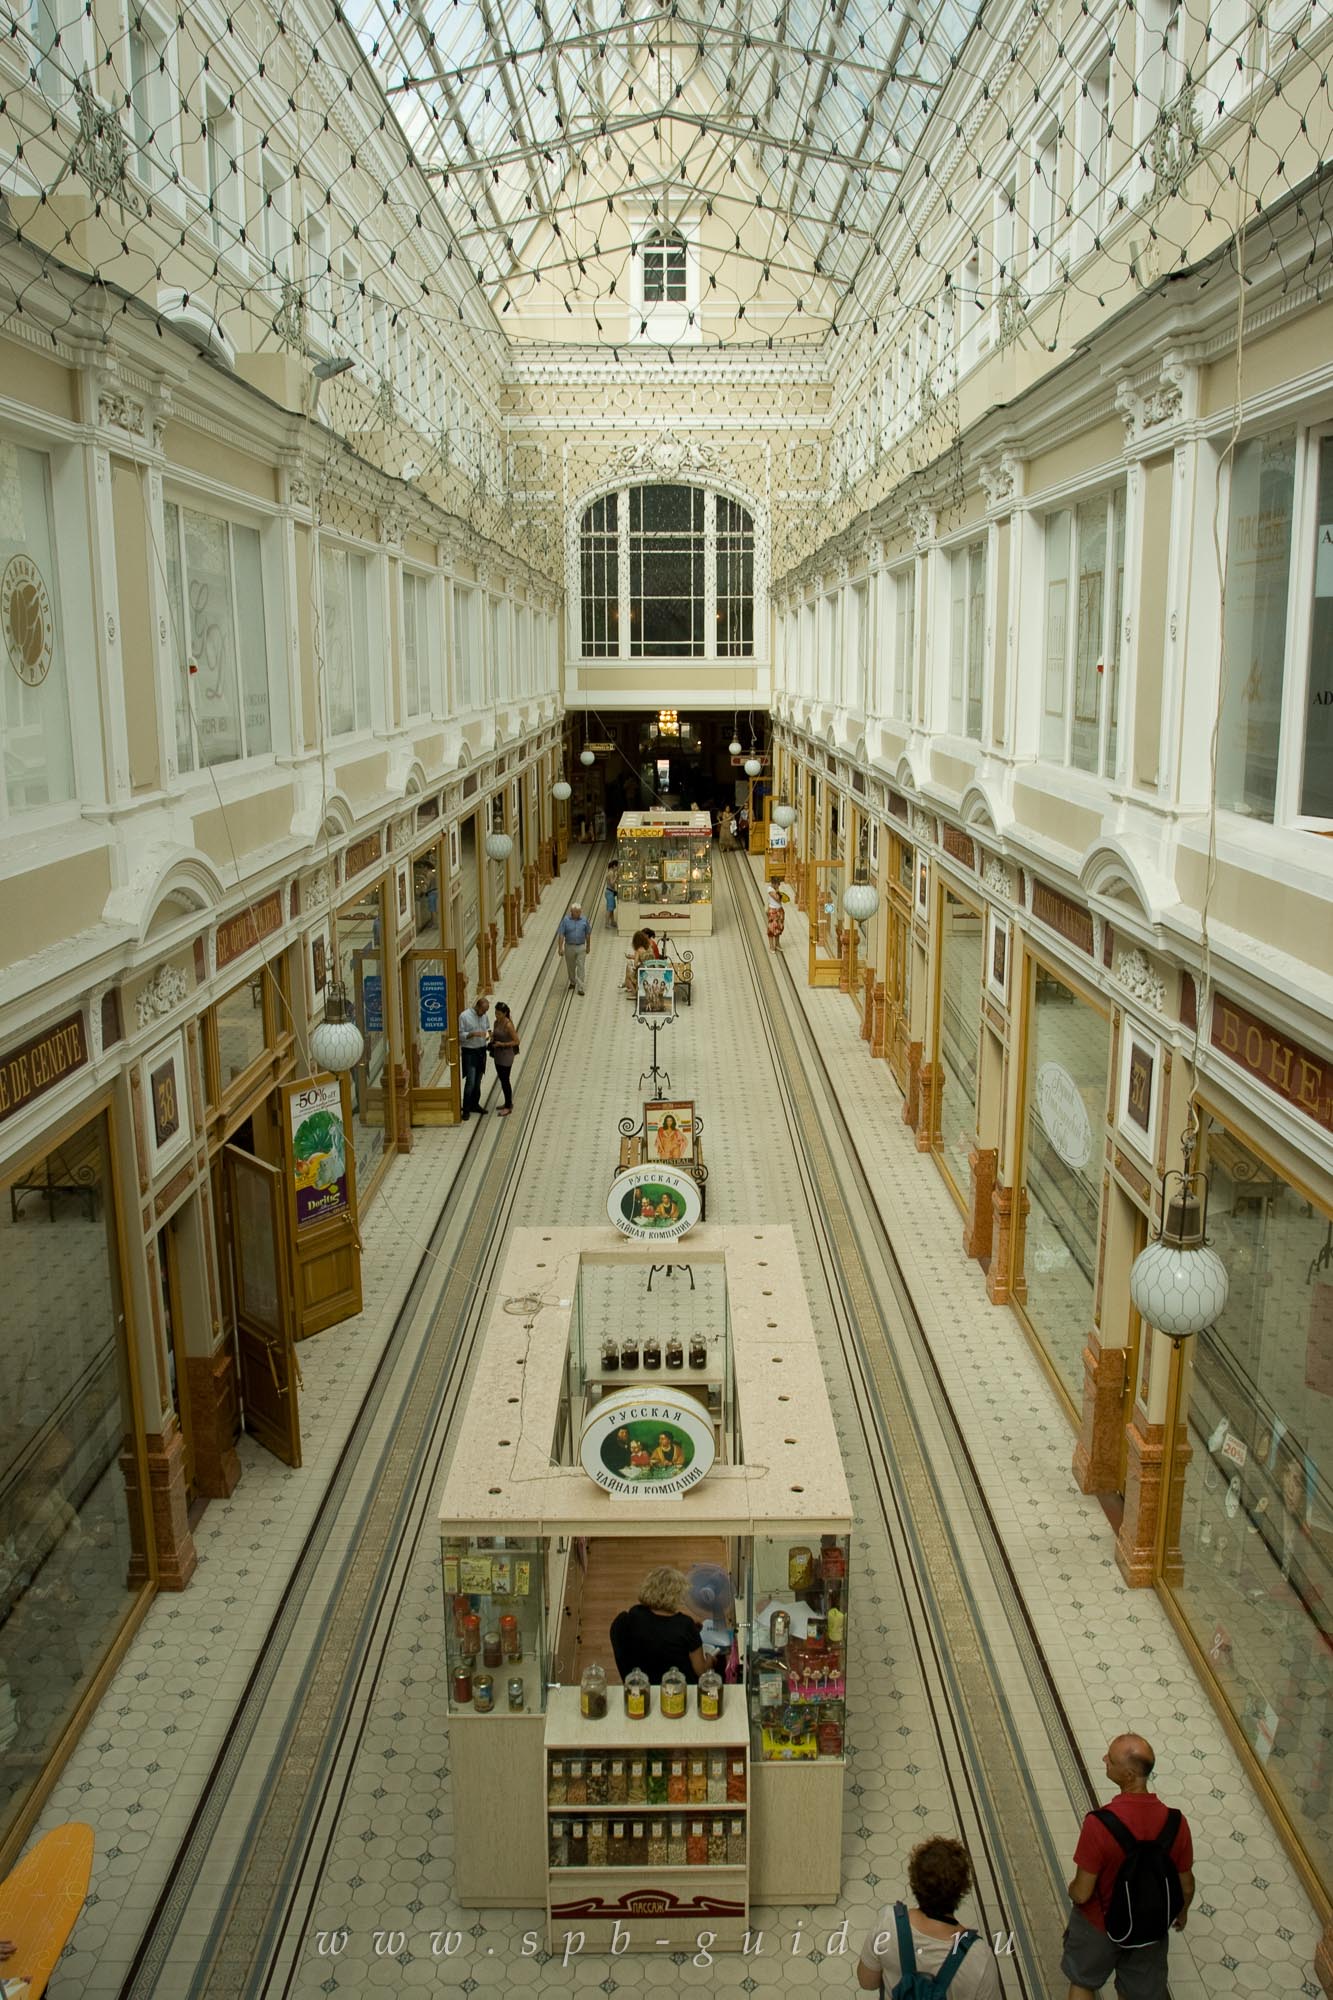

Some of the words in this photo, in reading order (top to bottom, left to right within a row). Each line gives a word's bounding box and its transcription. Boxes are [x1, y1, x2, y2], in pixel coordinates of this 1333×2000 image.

[619, 829, 634, 837] At
[9, 1055, 31, 1103] DE
[1131, 1061, 1147, 1113] 37
[158, 1077, 175, 1127] 38
[296, 1088, 327, 1109] -50%
[628, 1174, 680, 1186] РУССКАЯ
[616, 1218, 646, 1238] ЧАЙНАЯ
[648, 1219, 692, 1240] КОМПАНИЯ
[608, 1407, 682, 1424] РУССКАЯ
[1223, 1442, 1245, 1463] 20%
[596, 1471, 639, 1495] ЧАЙНАЯ
[644, 1466, 703, 1495] КОМПАНИЯ
[632, 1902, 666, 1914] ПАССАЖ
